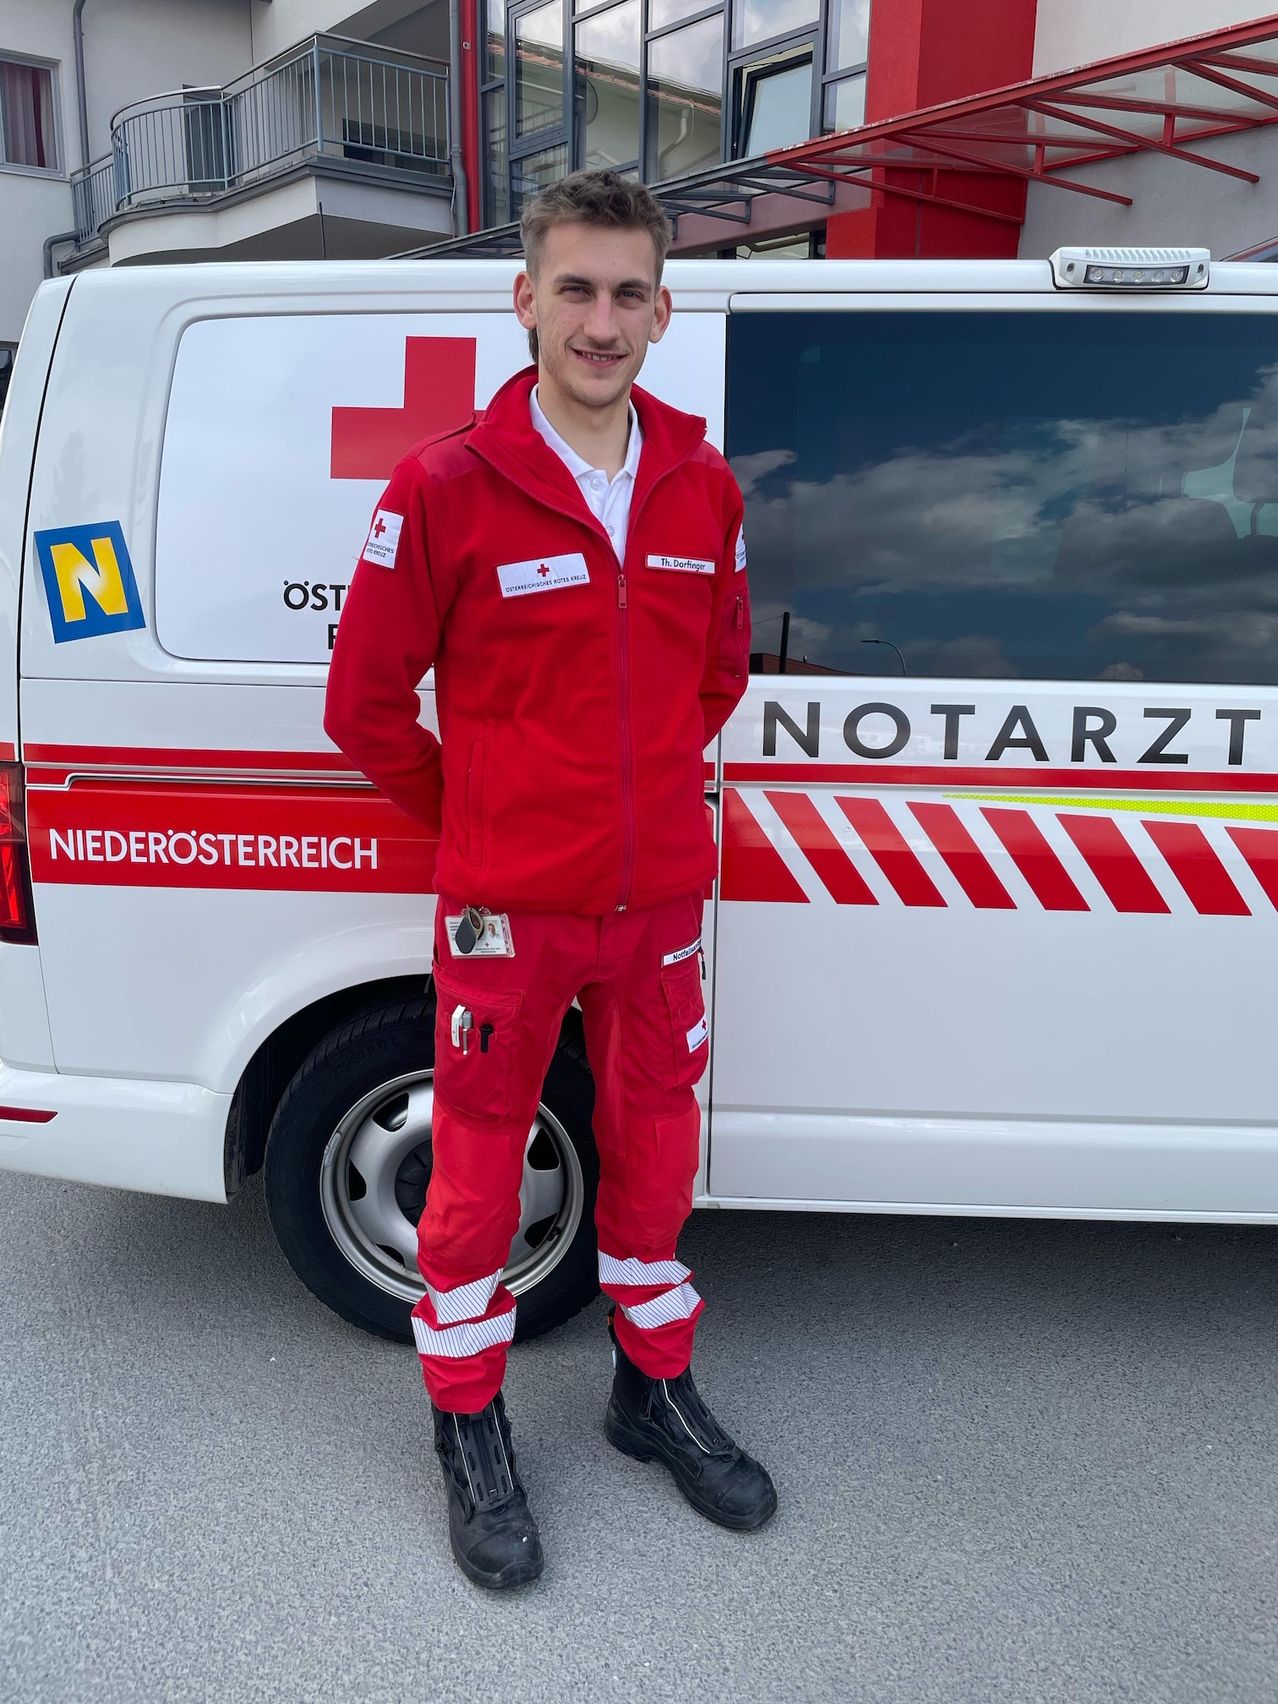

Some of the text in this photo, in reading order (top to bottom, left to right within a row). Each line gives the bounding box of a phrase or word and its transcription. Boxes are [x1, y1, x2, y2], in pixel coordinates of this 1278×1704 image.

[50, 537, 128, 622] N
[570, 573, 587, 582] KREUZ
[660, 557, 706, 572] Th. Dorfinger
[283, 580, 350, 611] ÖST
[762, 701, 1262, 766] NOTARZT
[49, 829, 378, 870] NIEDERÖSTERREICH
